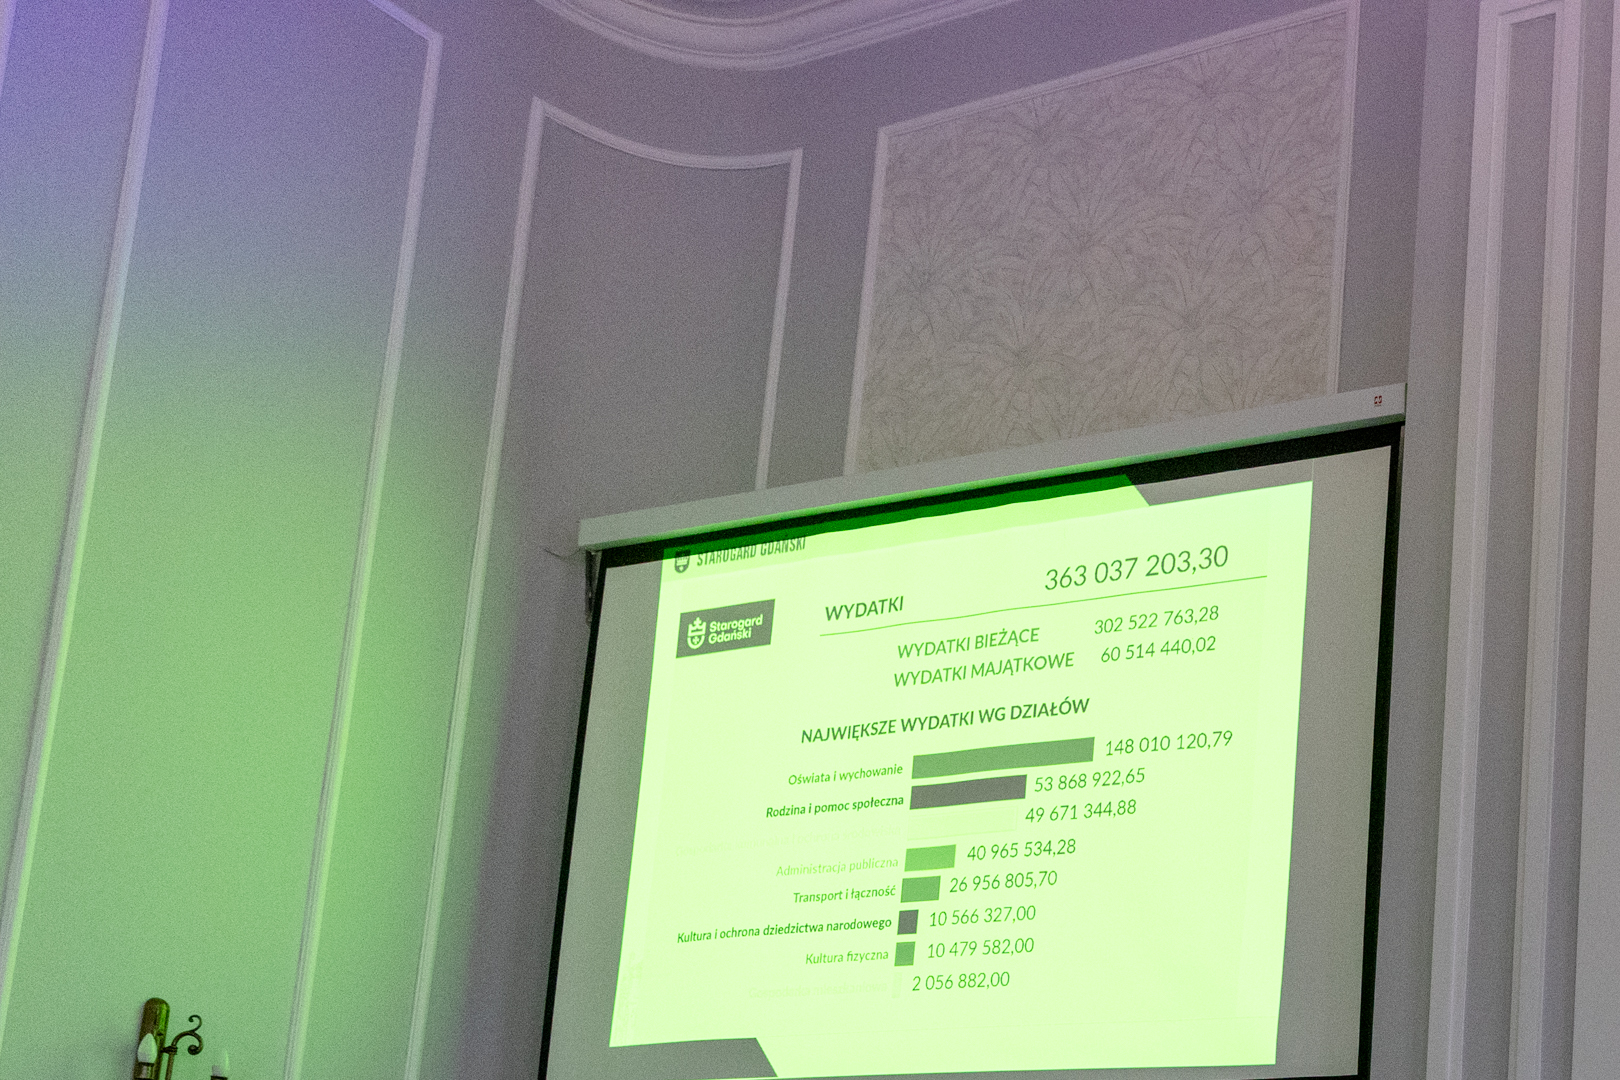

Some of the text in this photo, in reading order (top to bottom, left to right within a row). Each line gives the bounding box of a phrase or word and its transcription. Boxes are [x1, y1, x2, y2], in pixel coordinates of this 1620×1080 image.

[1045, 545, 1229, 590] 363 037 203,30
[825, 595, 904, 621] WYDATKI
[1094, 605, 1219, 634] 302 522 763,28
[709, 614, 763, 633] Starogard
[708, 628, 752, 645] Gdański
[897, 627, 1040, 659] WYDATKI BIEŻĄCE
[1100, 635, 1217, 662] 60 514 440,02
[893, 652, 1075, 687] WYDATKI MAJĄTKOWE
[801, 696, 1090, 744] NAJWIĘKSZE WYDATKI WG DZIAŁÓW
[1105, 730, 1233, 756] 148 010 120,79
[788, 763, 904, 785] Oświata i wychowanie
[1034, 767, 1146, 792] 53 868 922,65
[766, 796, 904, 818] Rodzina i pomoc społeczna
[1025, 799, 1137, 823] 49 671 344,88
[967, 838, 1076, 861] 40 965 534,28
[776, 856, 899, 877] Administracja publiczna
[949, 870, 1058, 893] 26 956 805,70
[793, 885, 896, 904] Transport i łączność
[929, 905, 1036, 927] 10 566 327,00
[677, 918, 892, 944] Kultura i ochrona dziedzictwa narodowego
[805, 949, 889, 965] Kultura fizyczna
[927, 937, 1034, 958] 10 479 582,00
[912, 971, 1010, 991] 2 056 882,00
